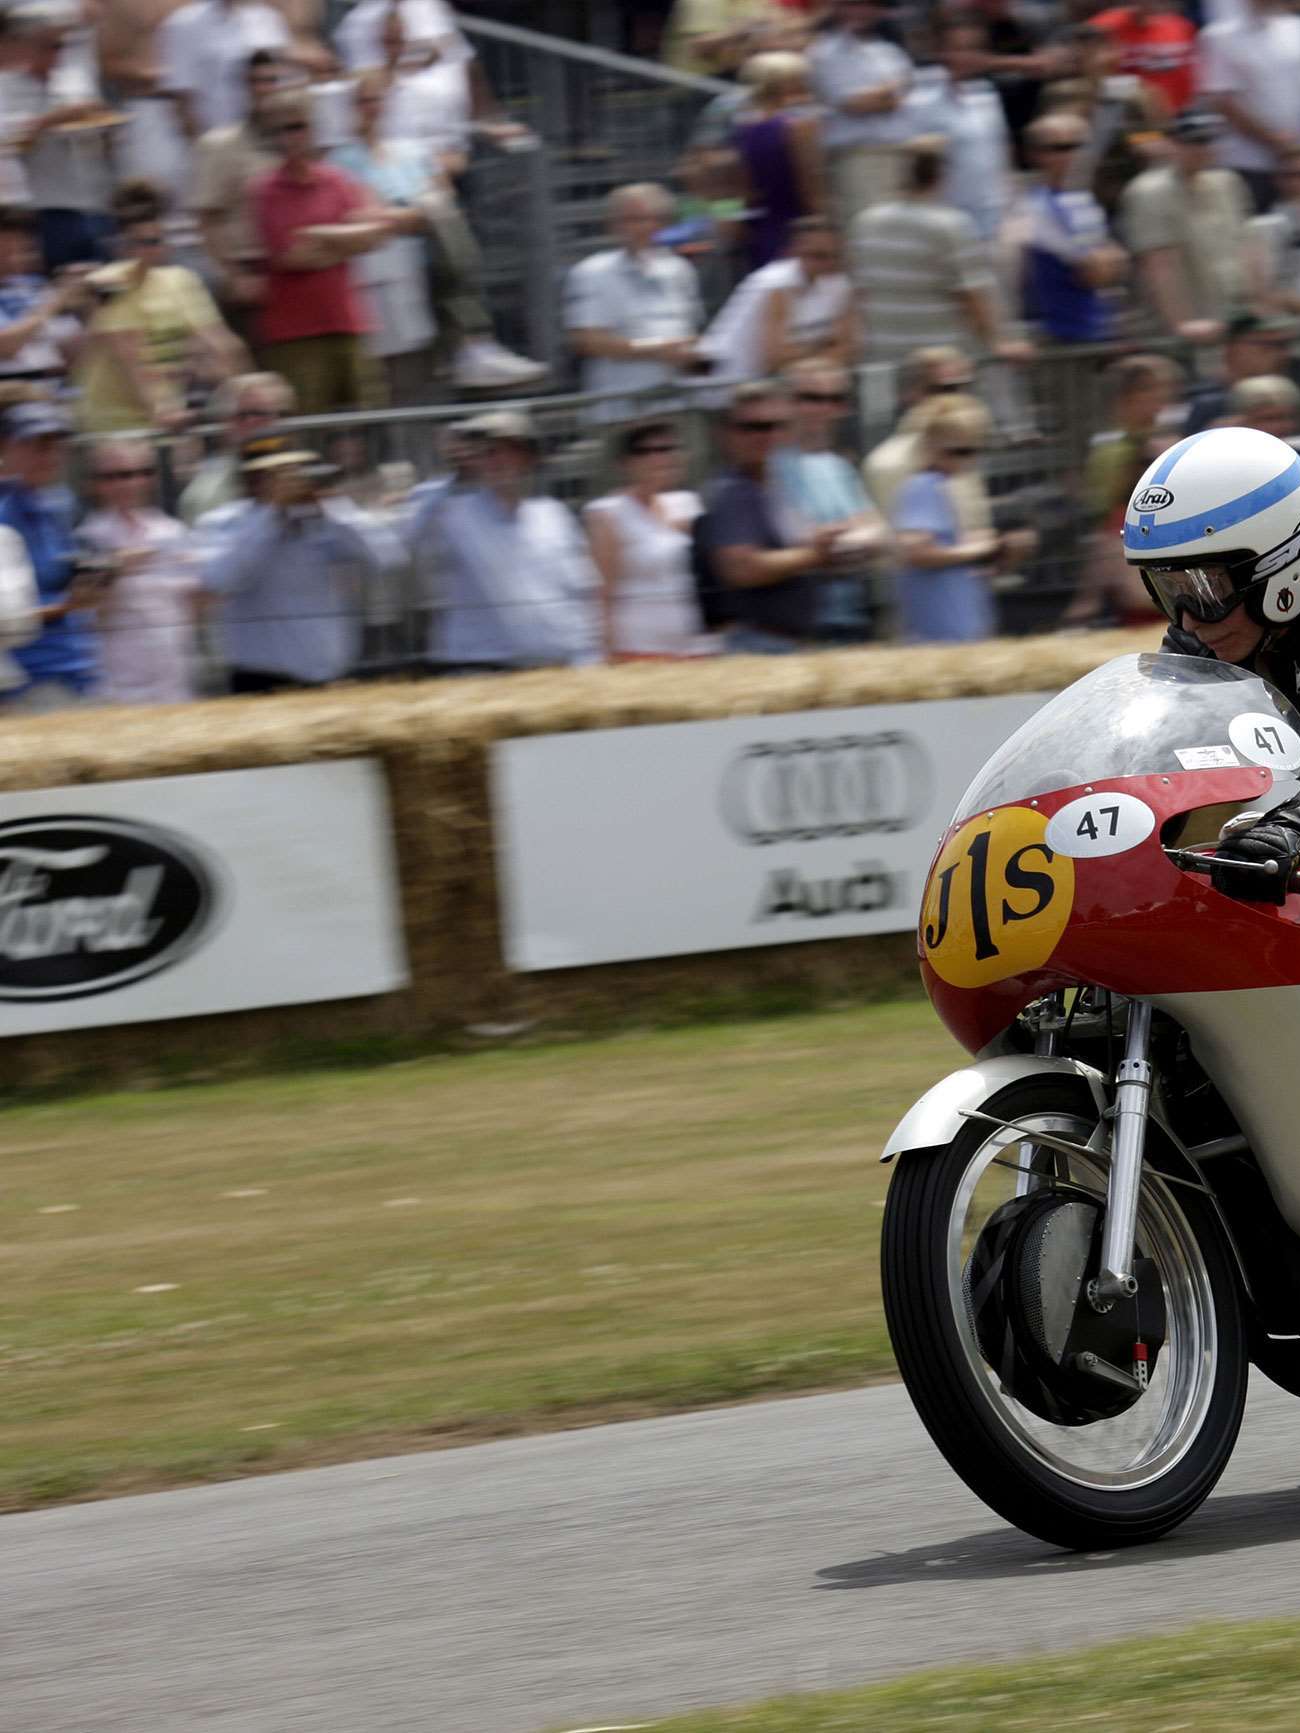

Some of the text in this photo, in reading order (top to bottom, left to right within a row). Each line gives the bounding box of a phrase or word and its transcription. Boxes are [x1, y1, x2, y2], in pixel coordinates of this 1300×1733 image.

[1135, 489, 1169, 504] Arai
[1254, 725, 1286, 755] 47
[1075, 805, 1120, 841] 47
